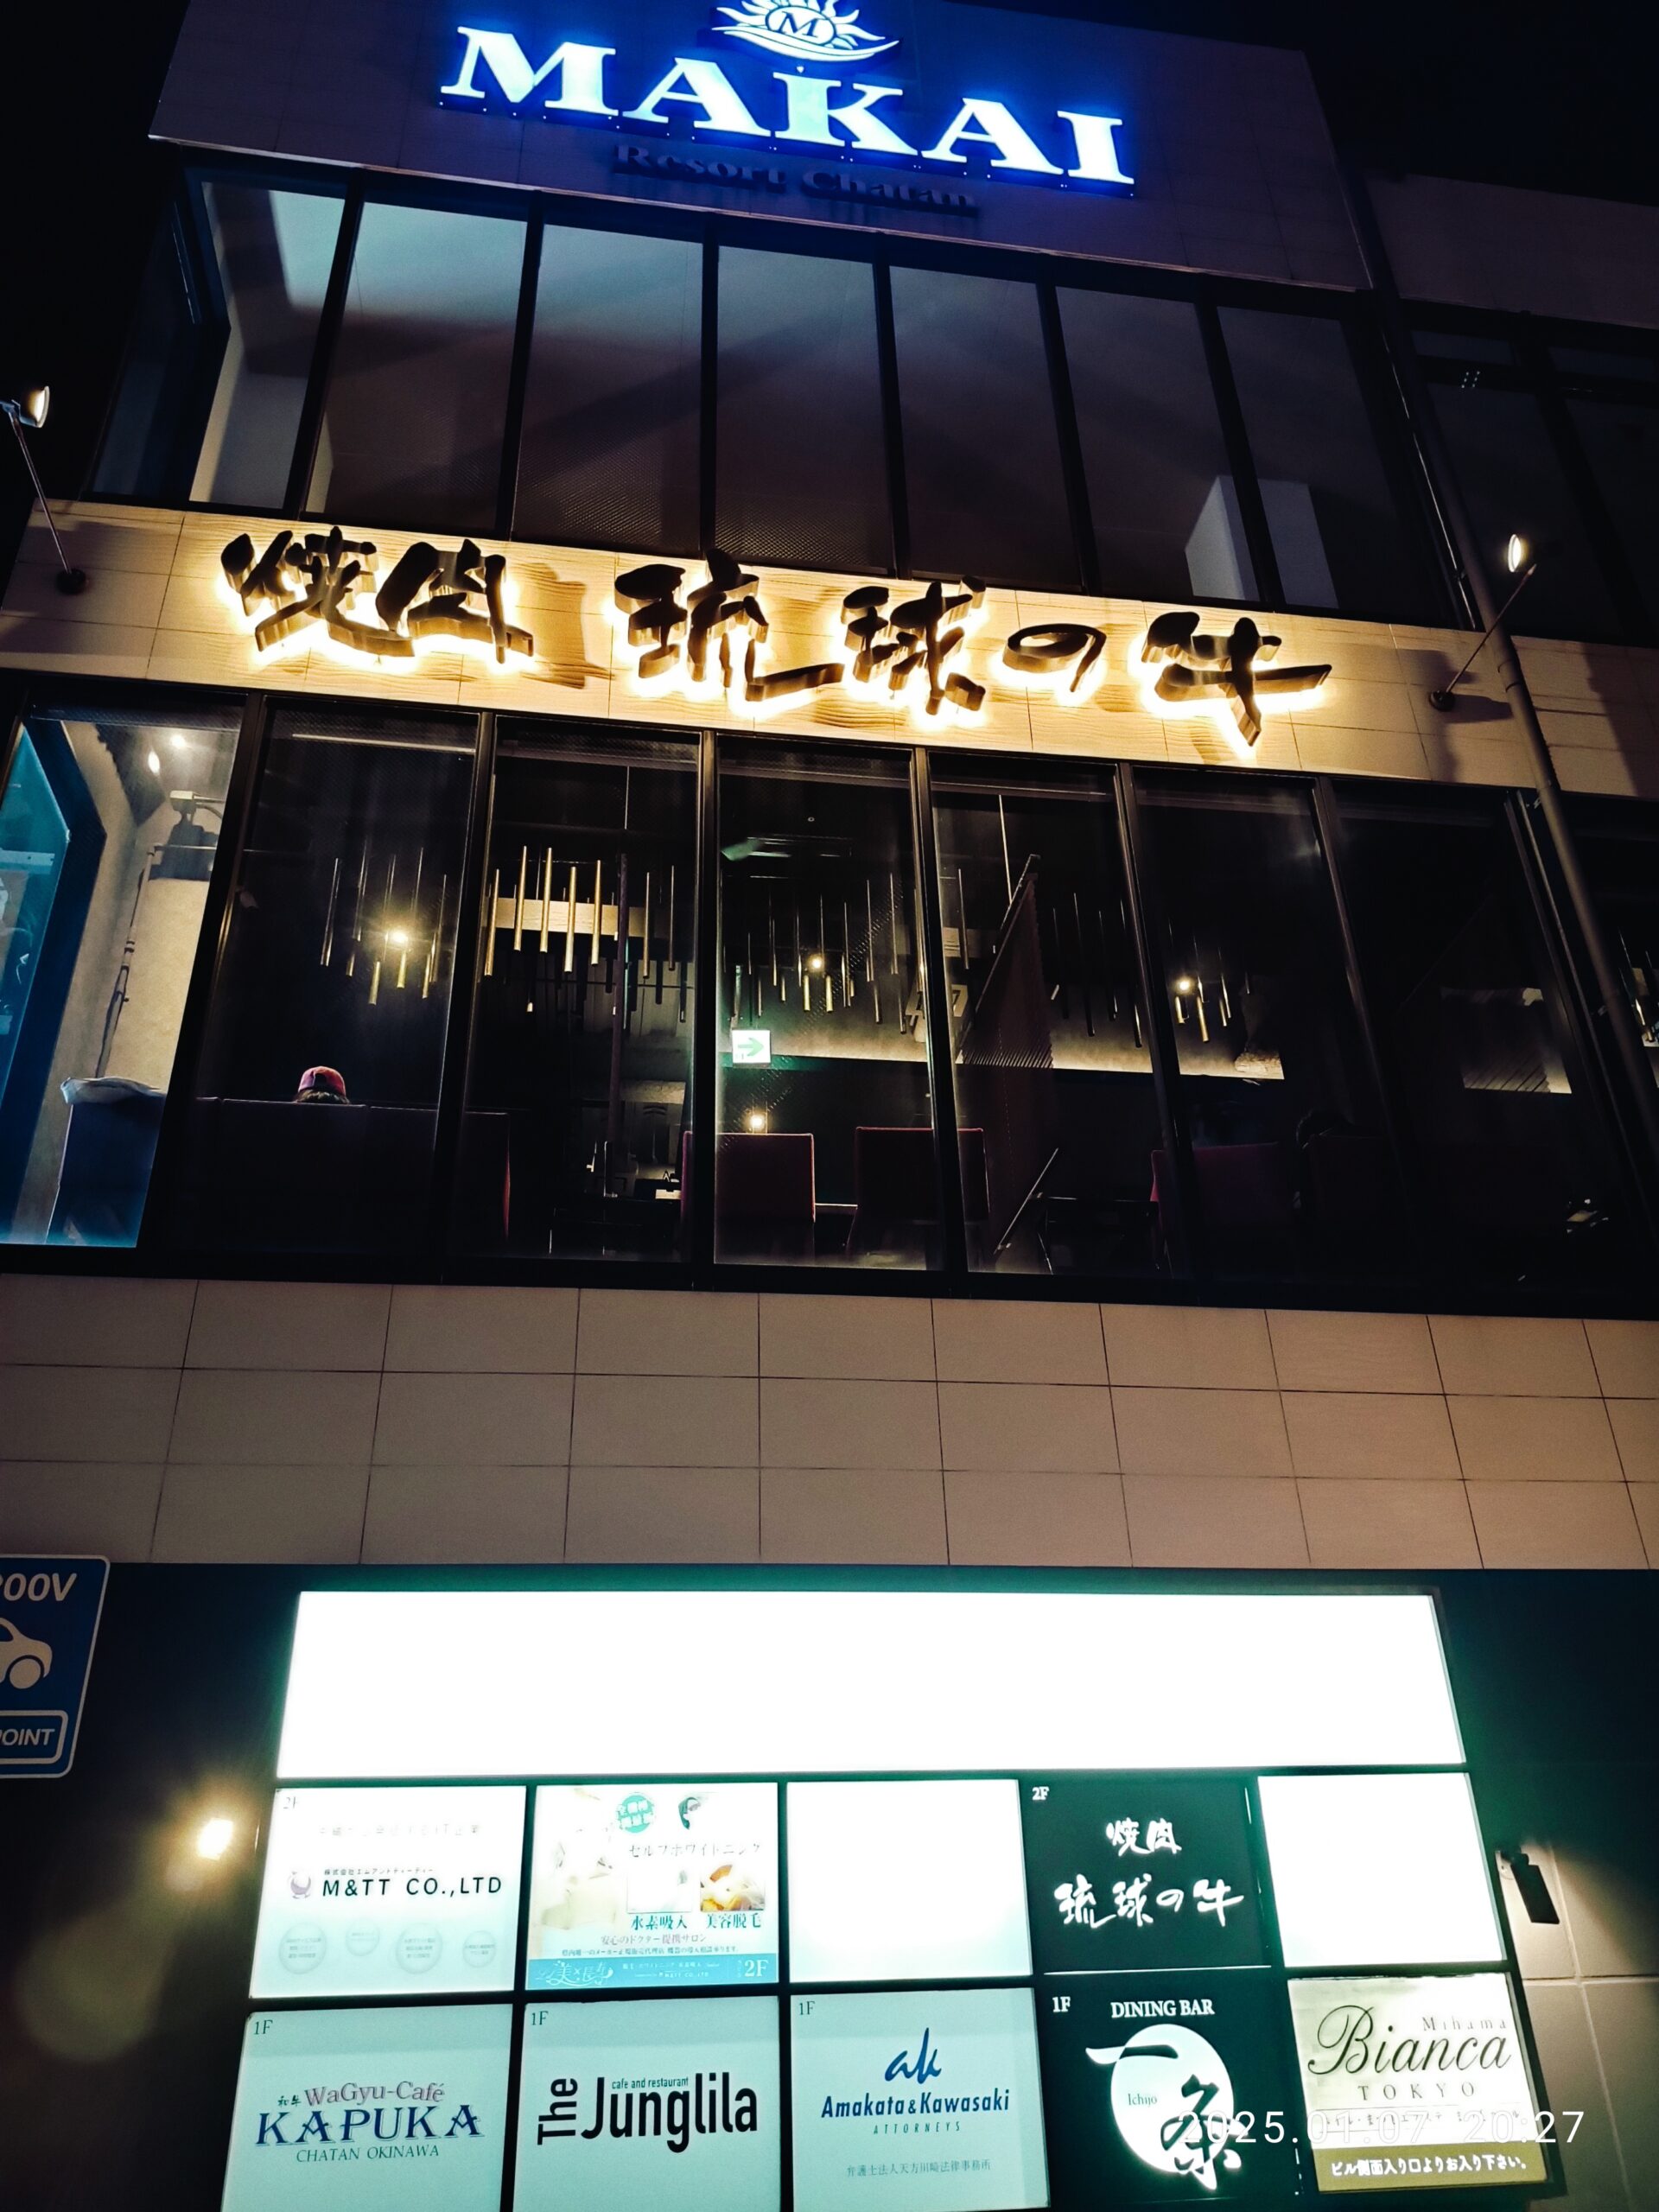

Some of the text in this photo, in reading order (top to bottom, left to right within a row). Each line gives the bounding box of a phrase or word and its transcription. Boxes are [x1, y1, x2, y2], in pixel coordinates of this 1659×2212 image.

[441, 27, 1135, 185] MAKAI
[614, 143, 980, 216] Resort Chatan
[220, 524, 1332, 748] 焼肉 琉球の牛
[0, 1573, 78, 1602] 00V
[0, 1728, 55, 1745] OINT
[1032, 1786, 1050, 1801] 2F
[1106, 1817, 1182, 1857] 焼肉
[322, 1876, 502, 1897] M&TT CO.,LTD
[1054, 1873, 1244, 1929] 琉球の牛
[631, 1914, 688, 1931] 水素吸入
[706, 1912, 762, 1929] 美容脱毛
[744, 1959, 769, 1977] 2F
[798, 2000, 816, 2016] 1F
[1052, 1996, 1071, 2013] 1F
[1110, 1999, 1216, 2018] DINING BAR
[254, 2019, 273, 2035] 1F
[531, 2011, 549, 2026] 1F
[1307, 2005, 1512, 2075] Bianca
[612, 2076, 690, 2089] cafe and restaurant
[1357, 2081, 1475, 2102] TOKYO
[304, 2081, 446, 2106] WaGyu-Café
[537, 2078, 578, 2145] The
[581, 2071, 758, 2153] Junglila
[256, 2104, 485, 2146] KAPUKA
[874, 2120, 961, 2136] ATTORNEYS
[296, 2145, 439, 2163] CHATAN OKINAWA
